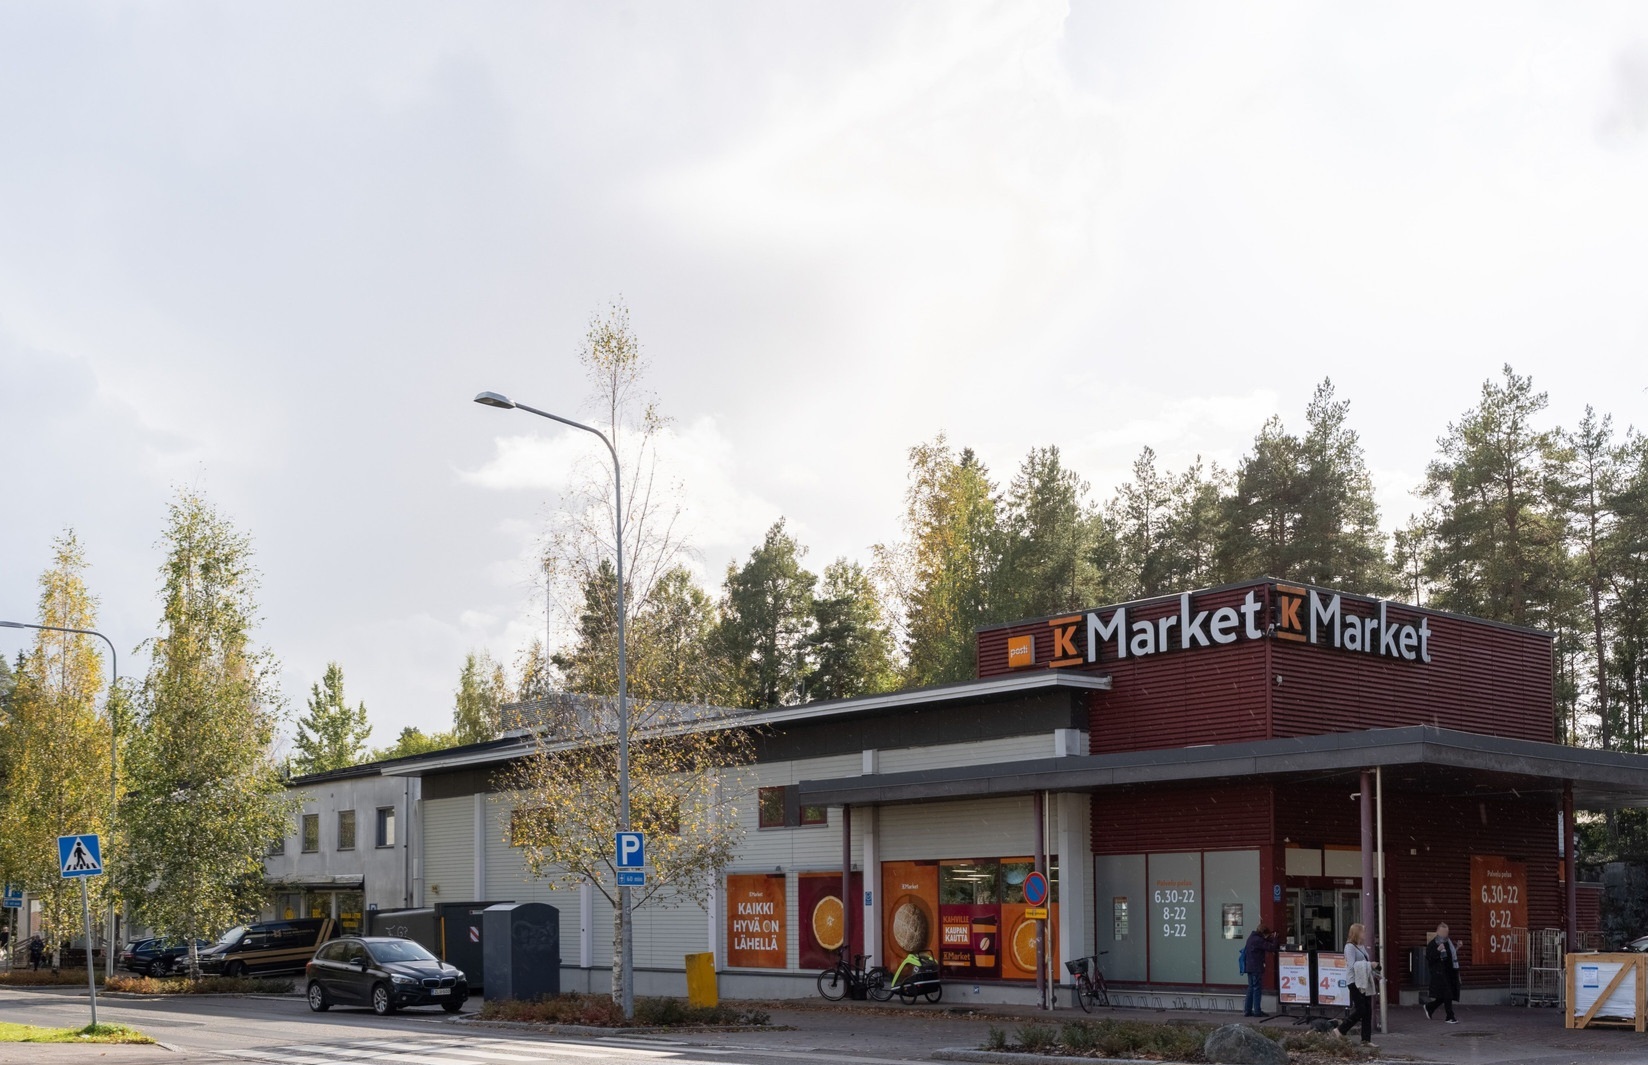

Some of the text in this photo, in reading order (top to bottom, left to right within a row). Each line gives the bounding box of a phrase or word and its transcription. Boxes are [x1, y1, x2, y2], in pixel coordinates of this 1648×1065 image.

[1087, 590, 1263, 663] Market
[1310, 589, 1432, 664] Market
[1010, 645, 1028, 658] posti
[621, 834, 640, 865] P
[1154, 889, 1195, 903] 6.30-22
[1481, 885, 1519, 904] 6.30-22
[738, 902, 774, 915] KAIKKI
[1163, 906, 1187, 920] 8-22
[733, 916, 780, 933] HYVÄ ON
[943, 915, 969, 924] KAHVILLE
[1489, 910, 1511, 928] 8-22
[945, 926, 968, 934] KAUPAN
[1163, 923, 1187, 937] 9-22
[734, 934, 779, 950] LÄHELLÄ
[945, 934, 969, 943] KAUTTA
[1490, 934, 1512, 953] 9-22
